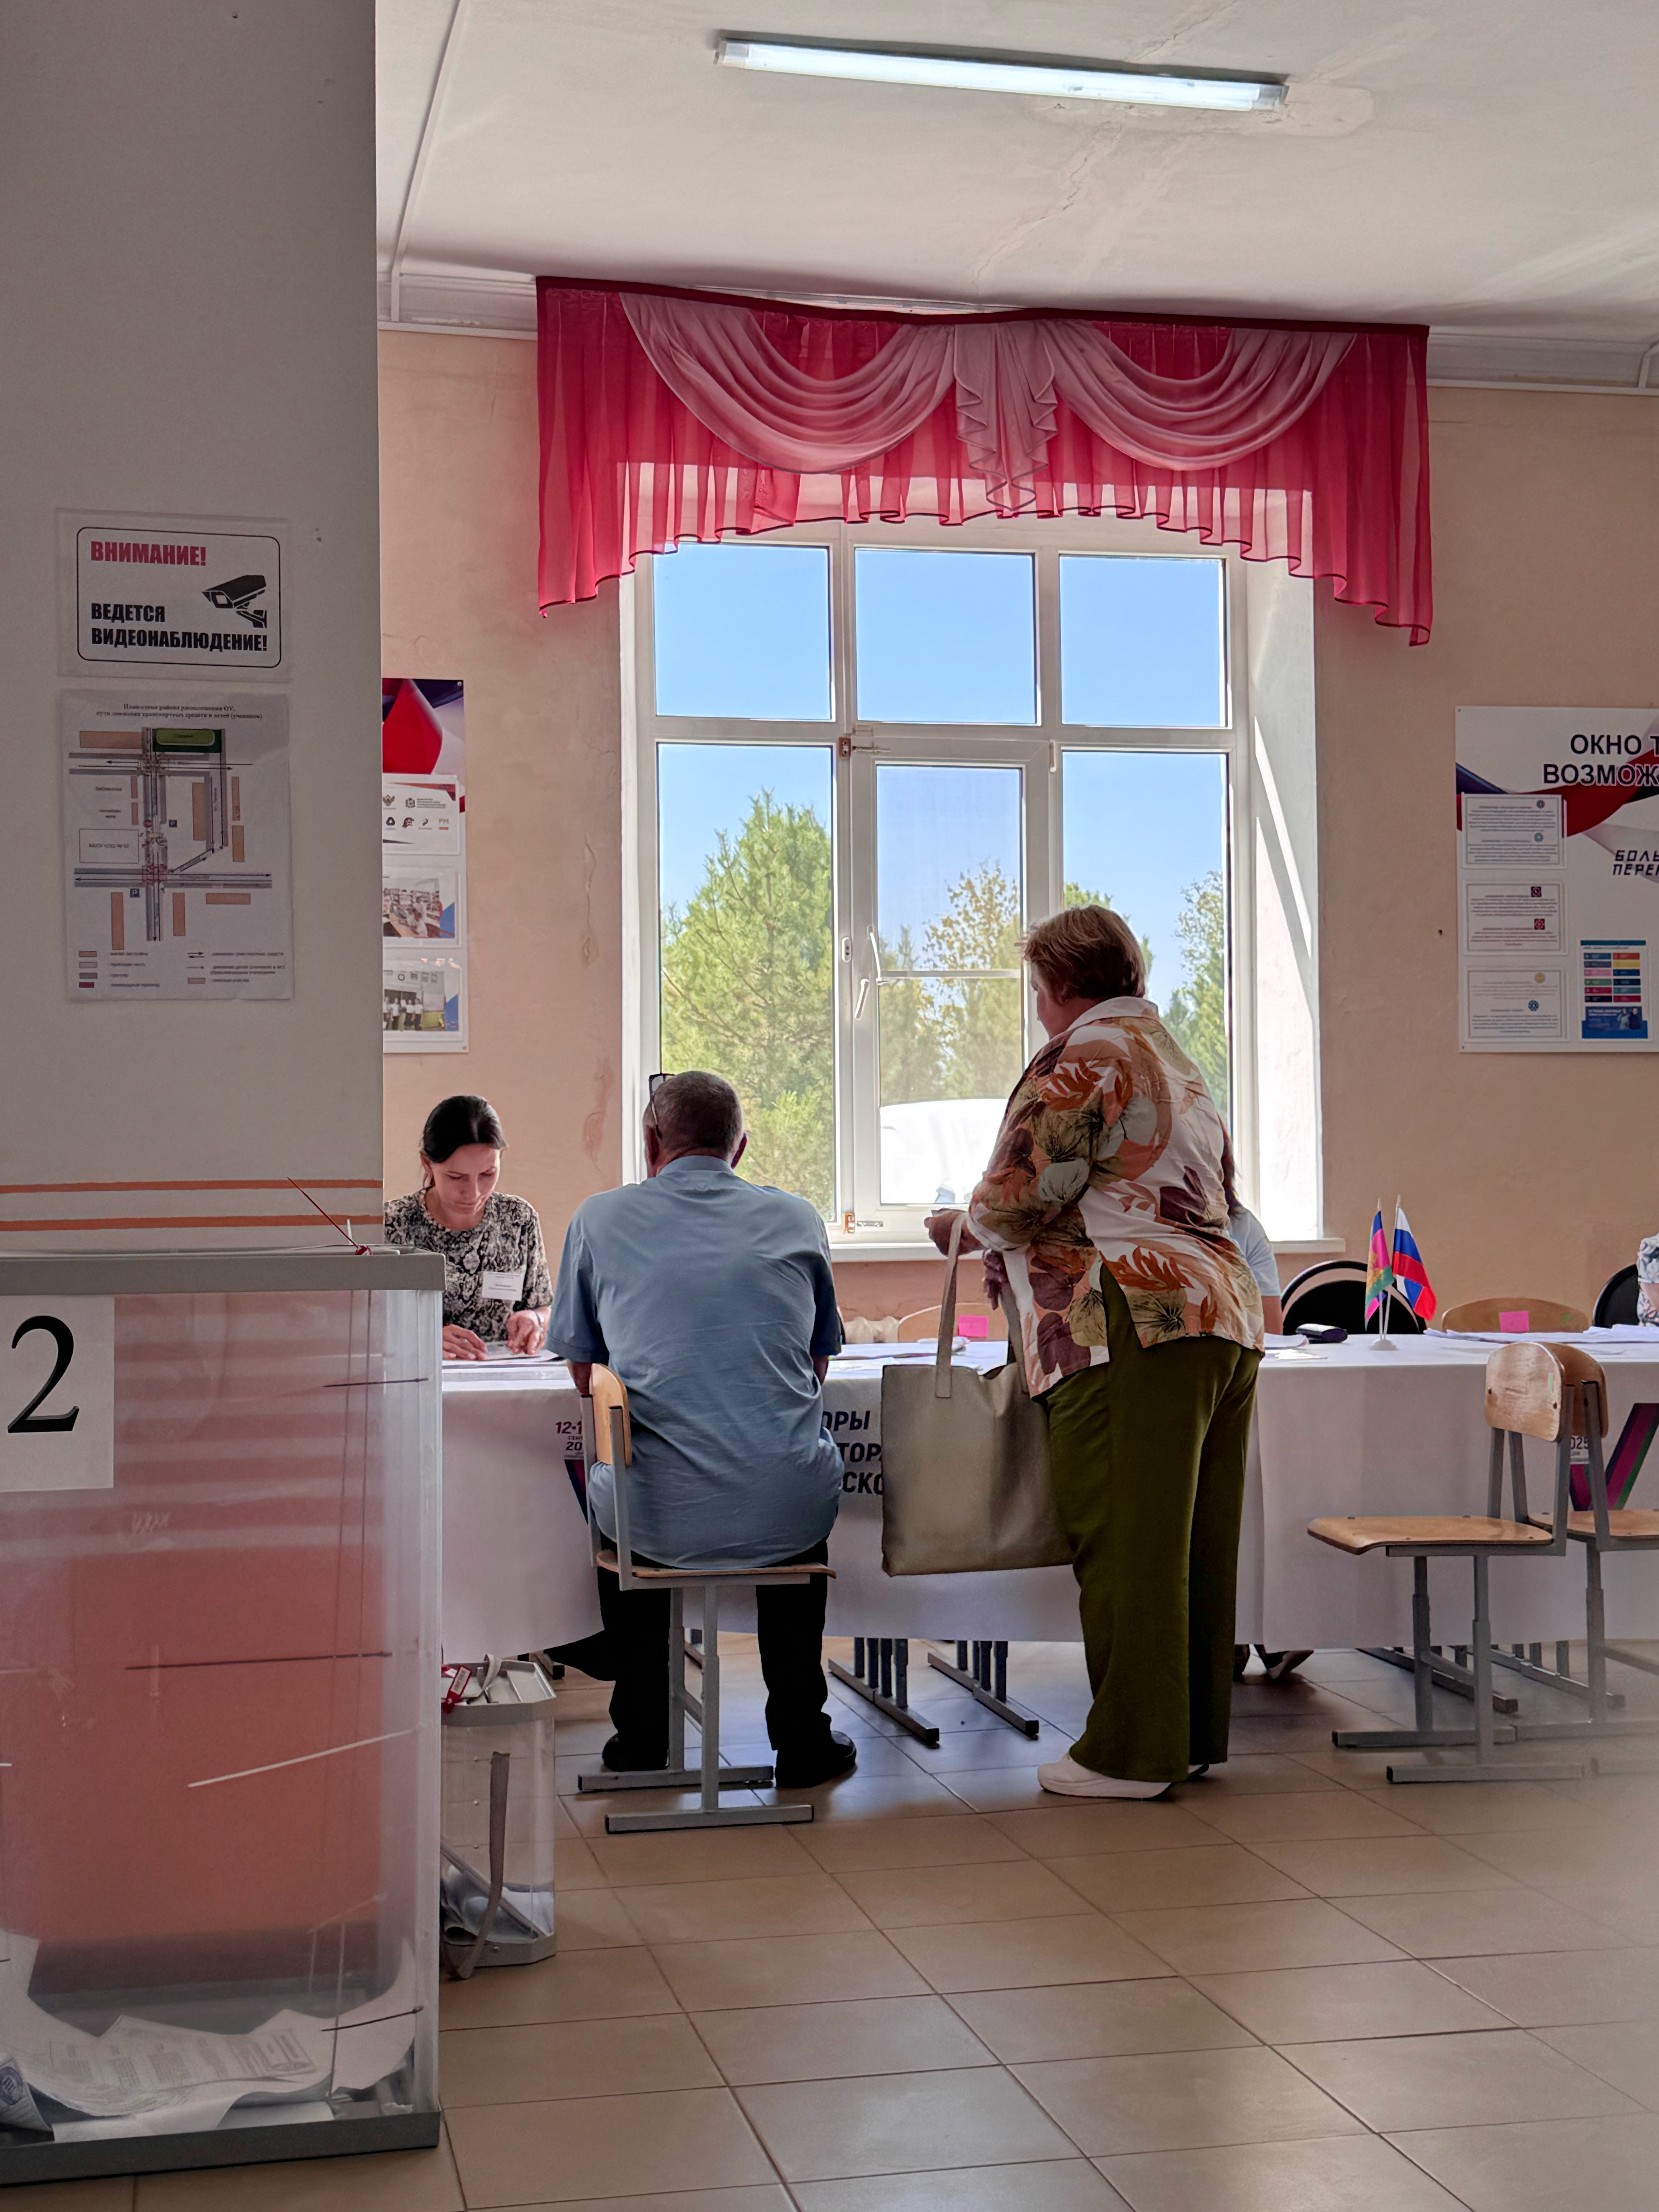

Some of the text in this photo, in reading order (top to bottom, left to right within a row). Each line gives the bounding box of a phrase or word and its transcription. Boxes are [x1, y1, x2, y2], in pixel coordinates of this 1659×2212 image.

[91, 541, 206, 566] ВНИМАНИЕ!
[91, 603, 165, 623] ВЕДЕТСЯ
[91, 628, 267, 652] ВИДЕОНАБЛЮДЕНИЕ!
[1570, 734, 1642, 755] ОКНО
[1544, 763, 1659, 786] ВОЗМОЖ
[8, 1315, 79, 1433] 2
[836, 1443, 882, 1463] ТОР
